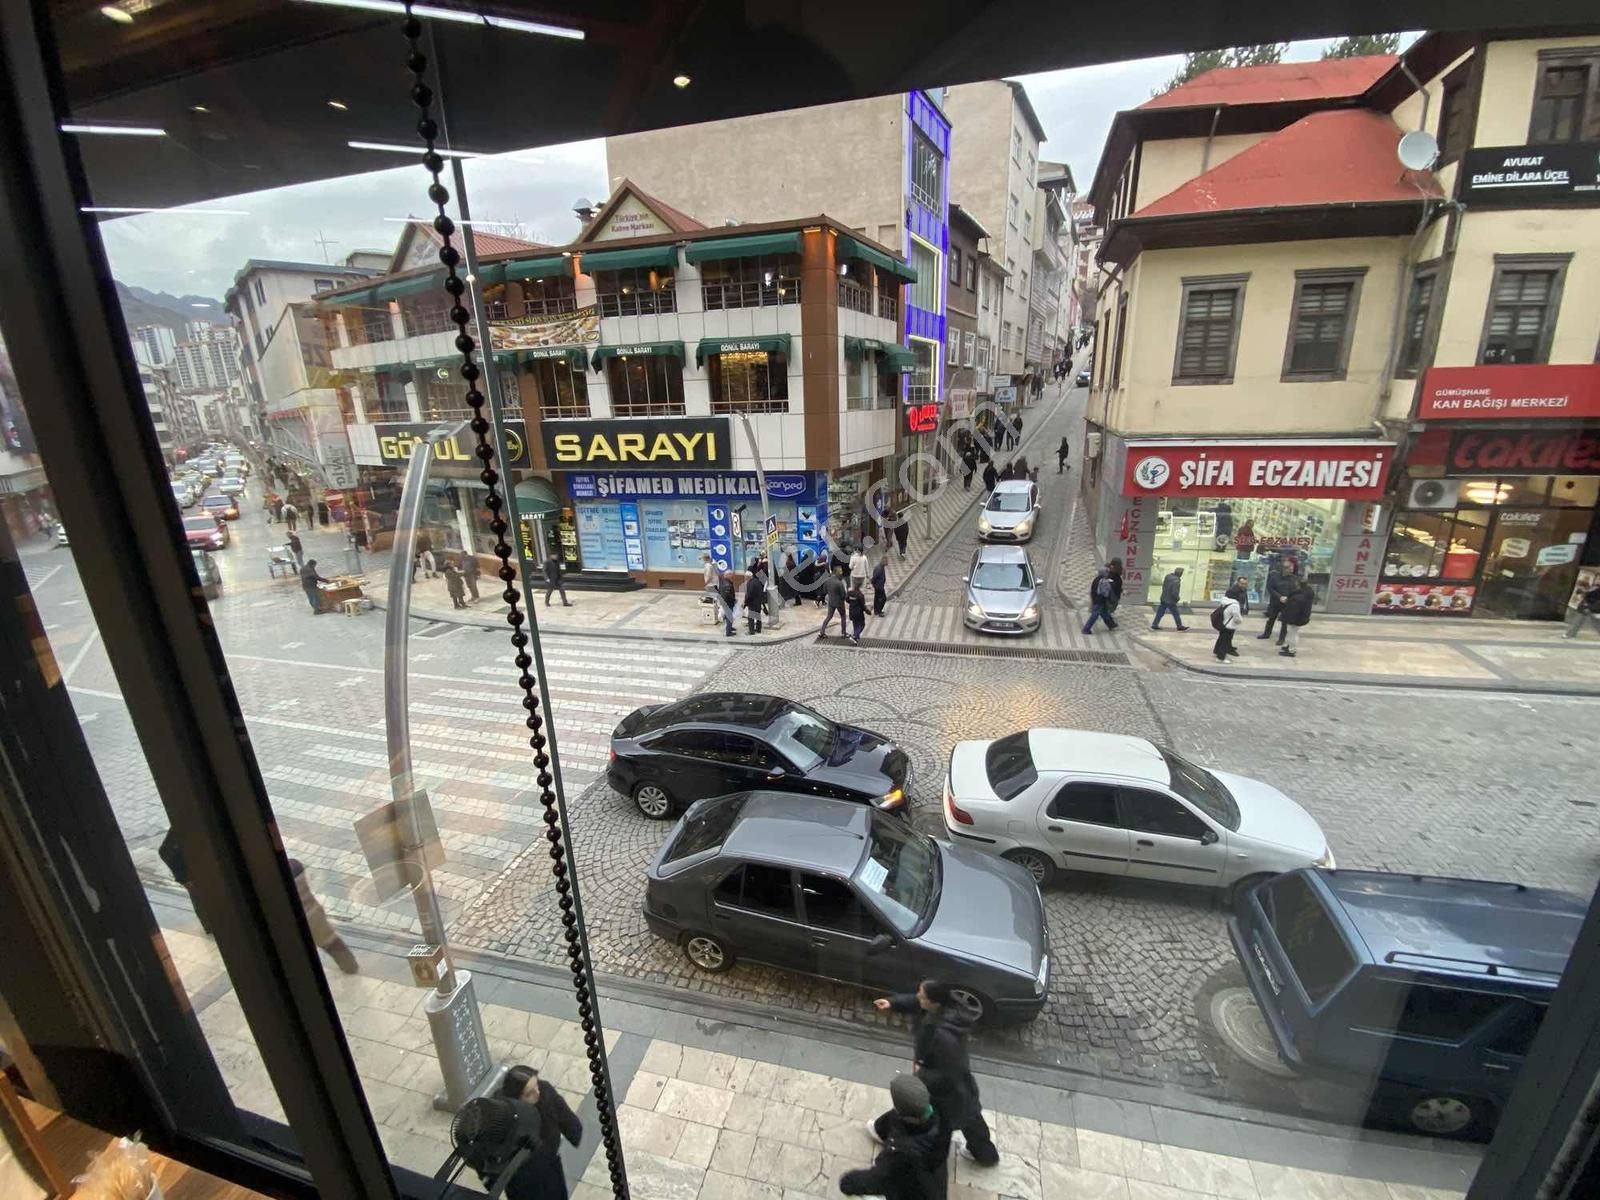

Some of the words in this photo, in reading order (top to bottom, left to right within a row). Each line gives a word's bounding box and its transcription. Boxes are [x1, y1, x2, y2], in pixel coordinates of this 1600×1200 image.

[1503, 156, 1545, 167] AVUKAT
[1472, 172, 1504, 183] EMİNE
[1505, 170, 1541, 182] DİLARA
[1543, 169, 1570, 182] ÜÇEL
[1435, 388, 1491, 396] GÜMÜŞHANE
[1432, 400, 1460, 409] KAN
[1463, 398, 1508, 410] BAĞIŞI
[1510, 396, 1569, 408] MERKEZİ
[554, 432, 716, 462] SARAYI
[1180, 453, 1235, 489] ŞİFA
[1249, 453, 1383, 487] ECZANESİ
[597, 475, 673, 497] ŞİFAMED
[678, 475, 760, 495] MEDİKAL
[1126, 496, 1143, 567] ECZANE
